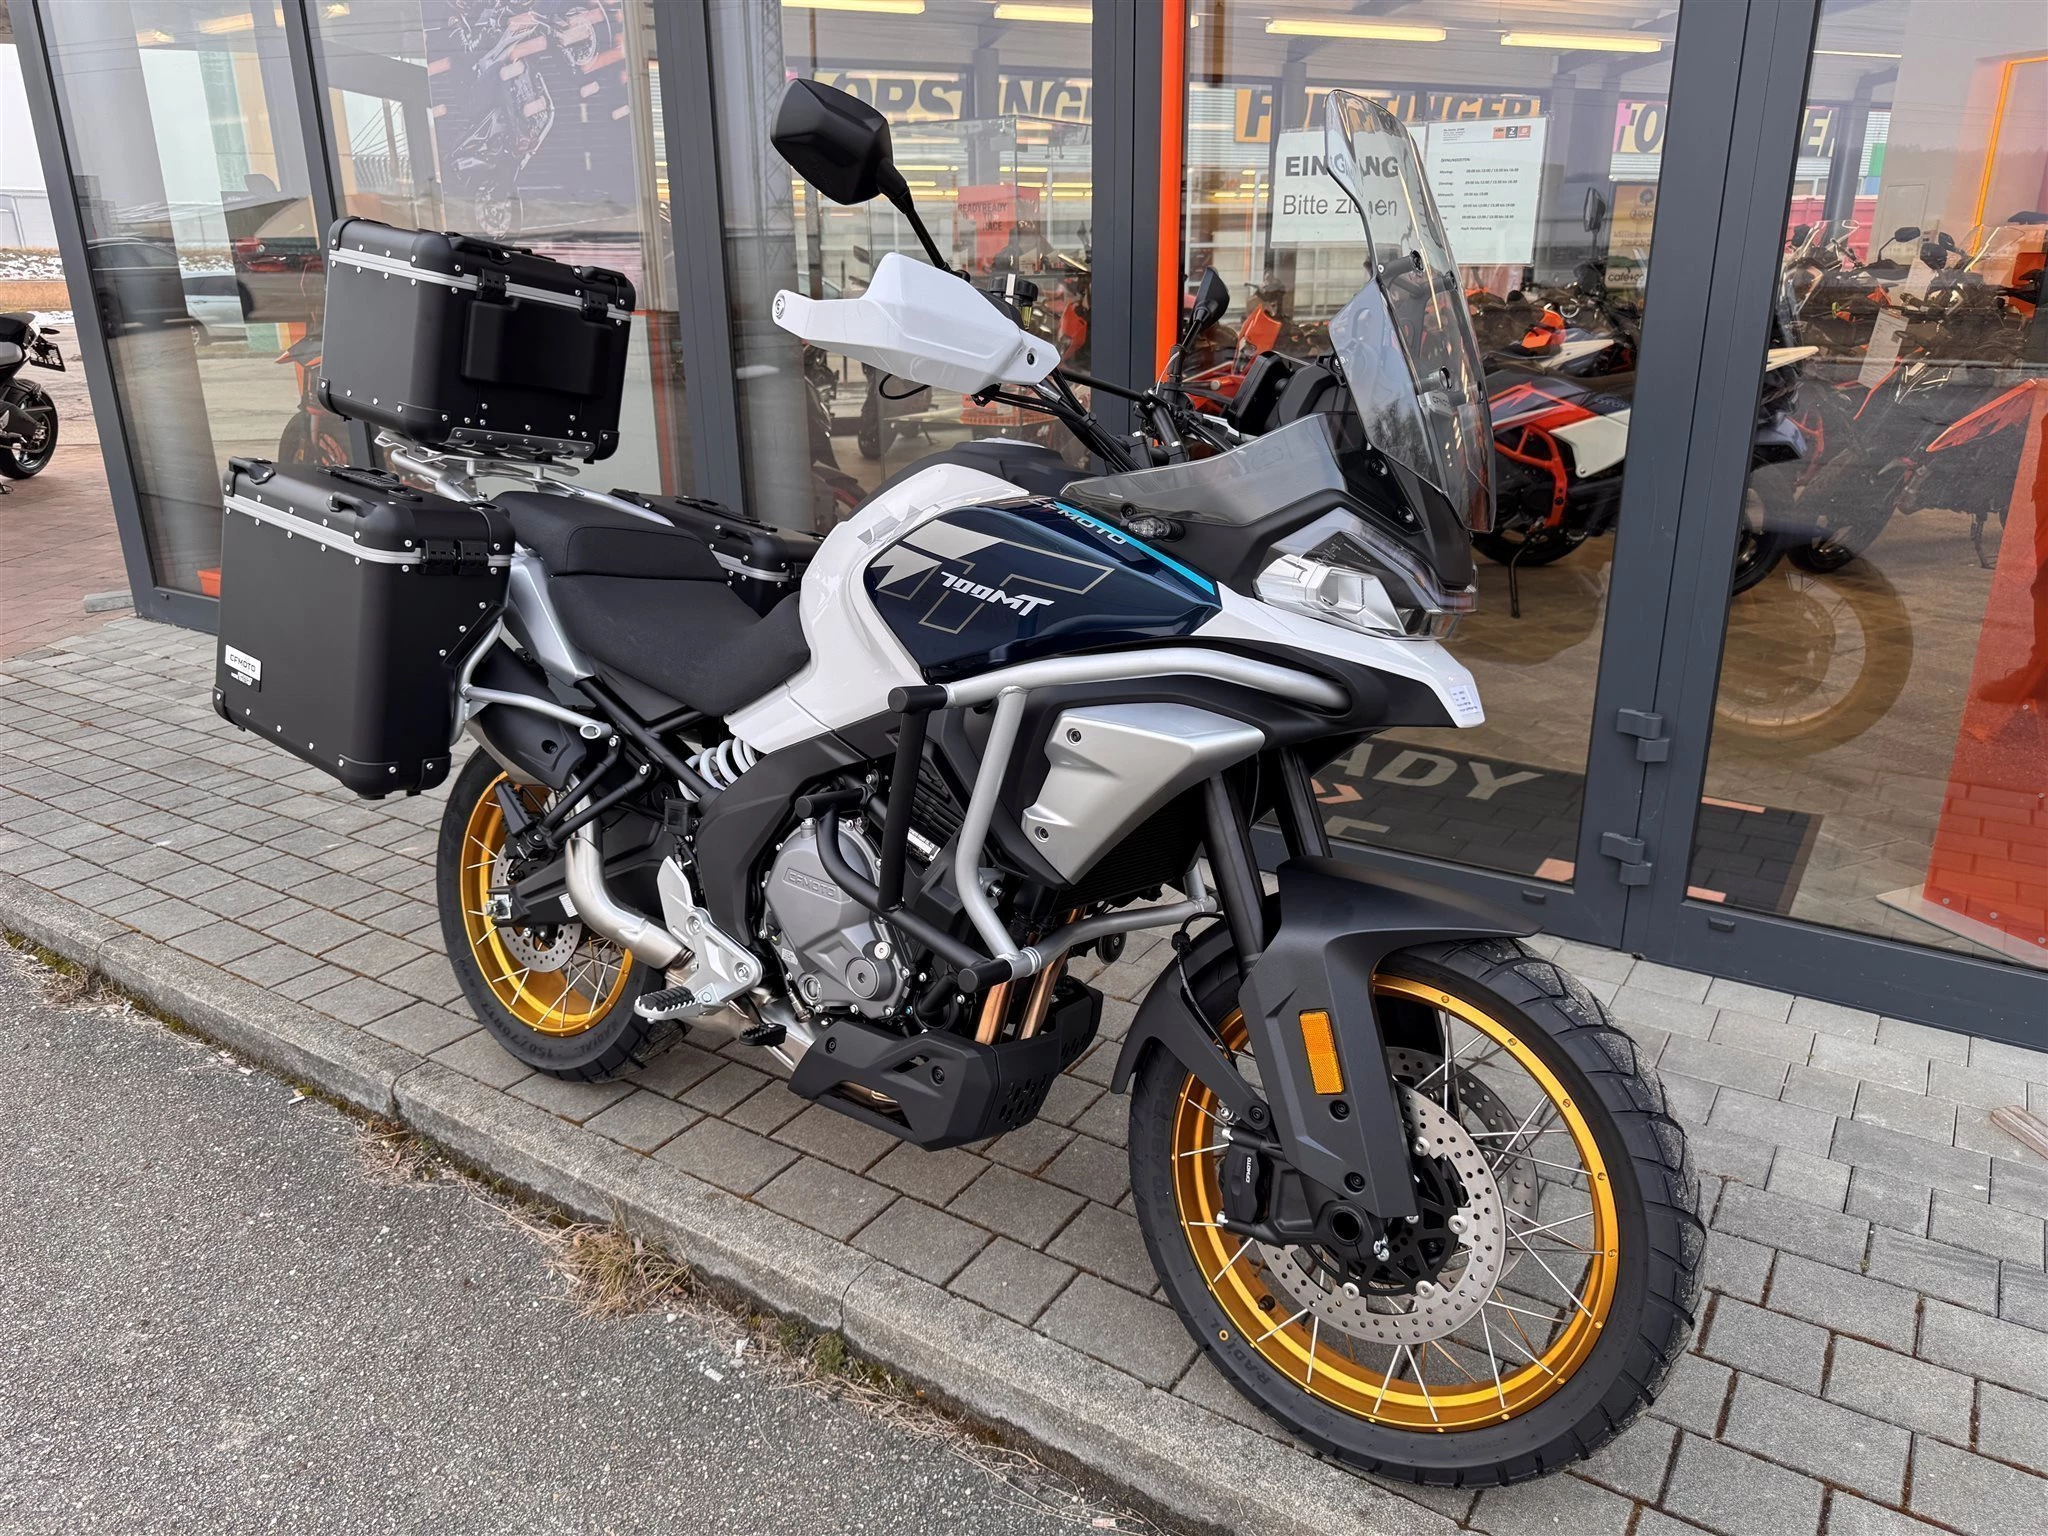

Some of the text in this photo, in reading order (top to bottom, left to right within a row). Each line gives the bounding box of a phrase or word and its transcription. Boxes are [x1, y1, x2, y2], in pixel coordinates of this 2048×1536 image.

[1283, 194, 1328, 215] Bitte
[941, 571, 1055, 617] 700MT
[230, 653, 256, 673] CFMOTO
[1331, 743, 1545, 801] ADY
[789, 871, 836, 898] CFMOTO
